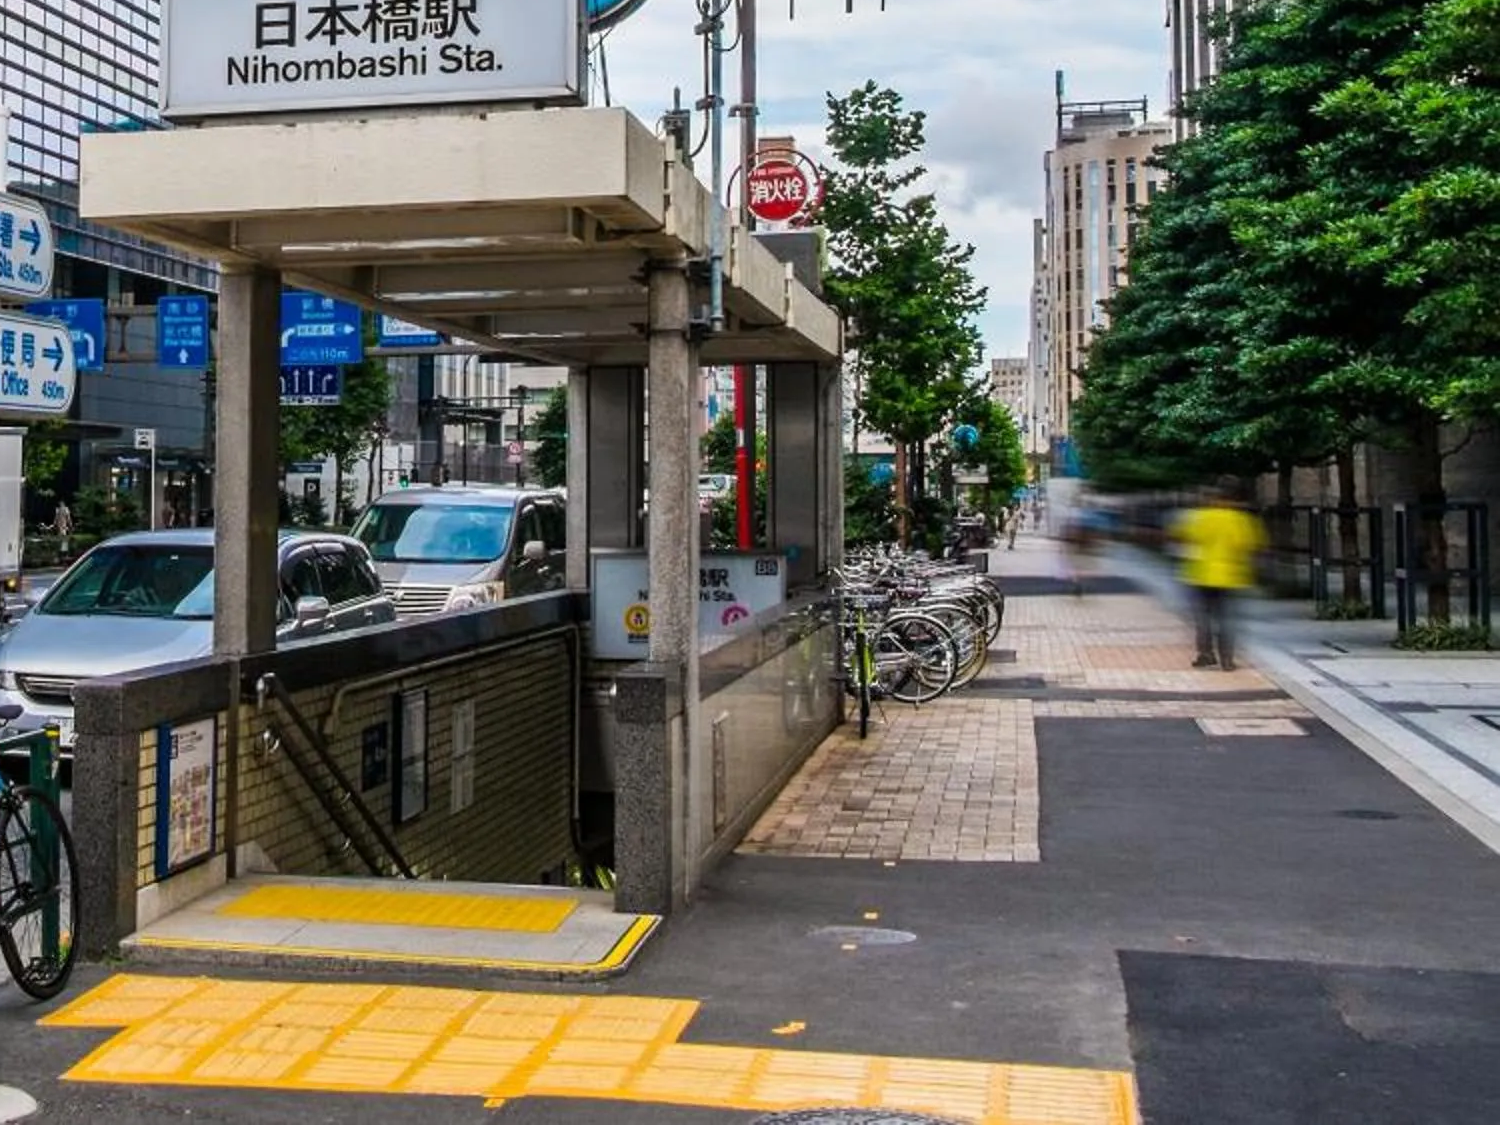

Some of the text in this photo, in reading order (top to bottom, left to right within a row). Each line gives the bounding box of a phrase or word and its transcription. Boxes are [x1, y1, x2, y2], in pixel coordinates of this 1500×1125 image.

[227, 42, 503, 86] Nihombashi Sta.
[749, 177, 804, 204] 消火栓
[1, 369, 29, 396] Office
